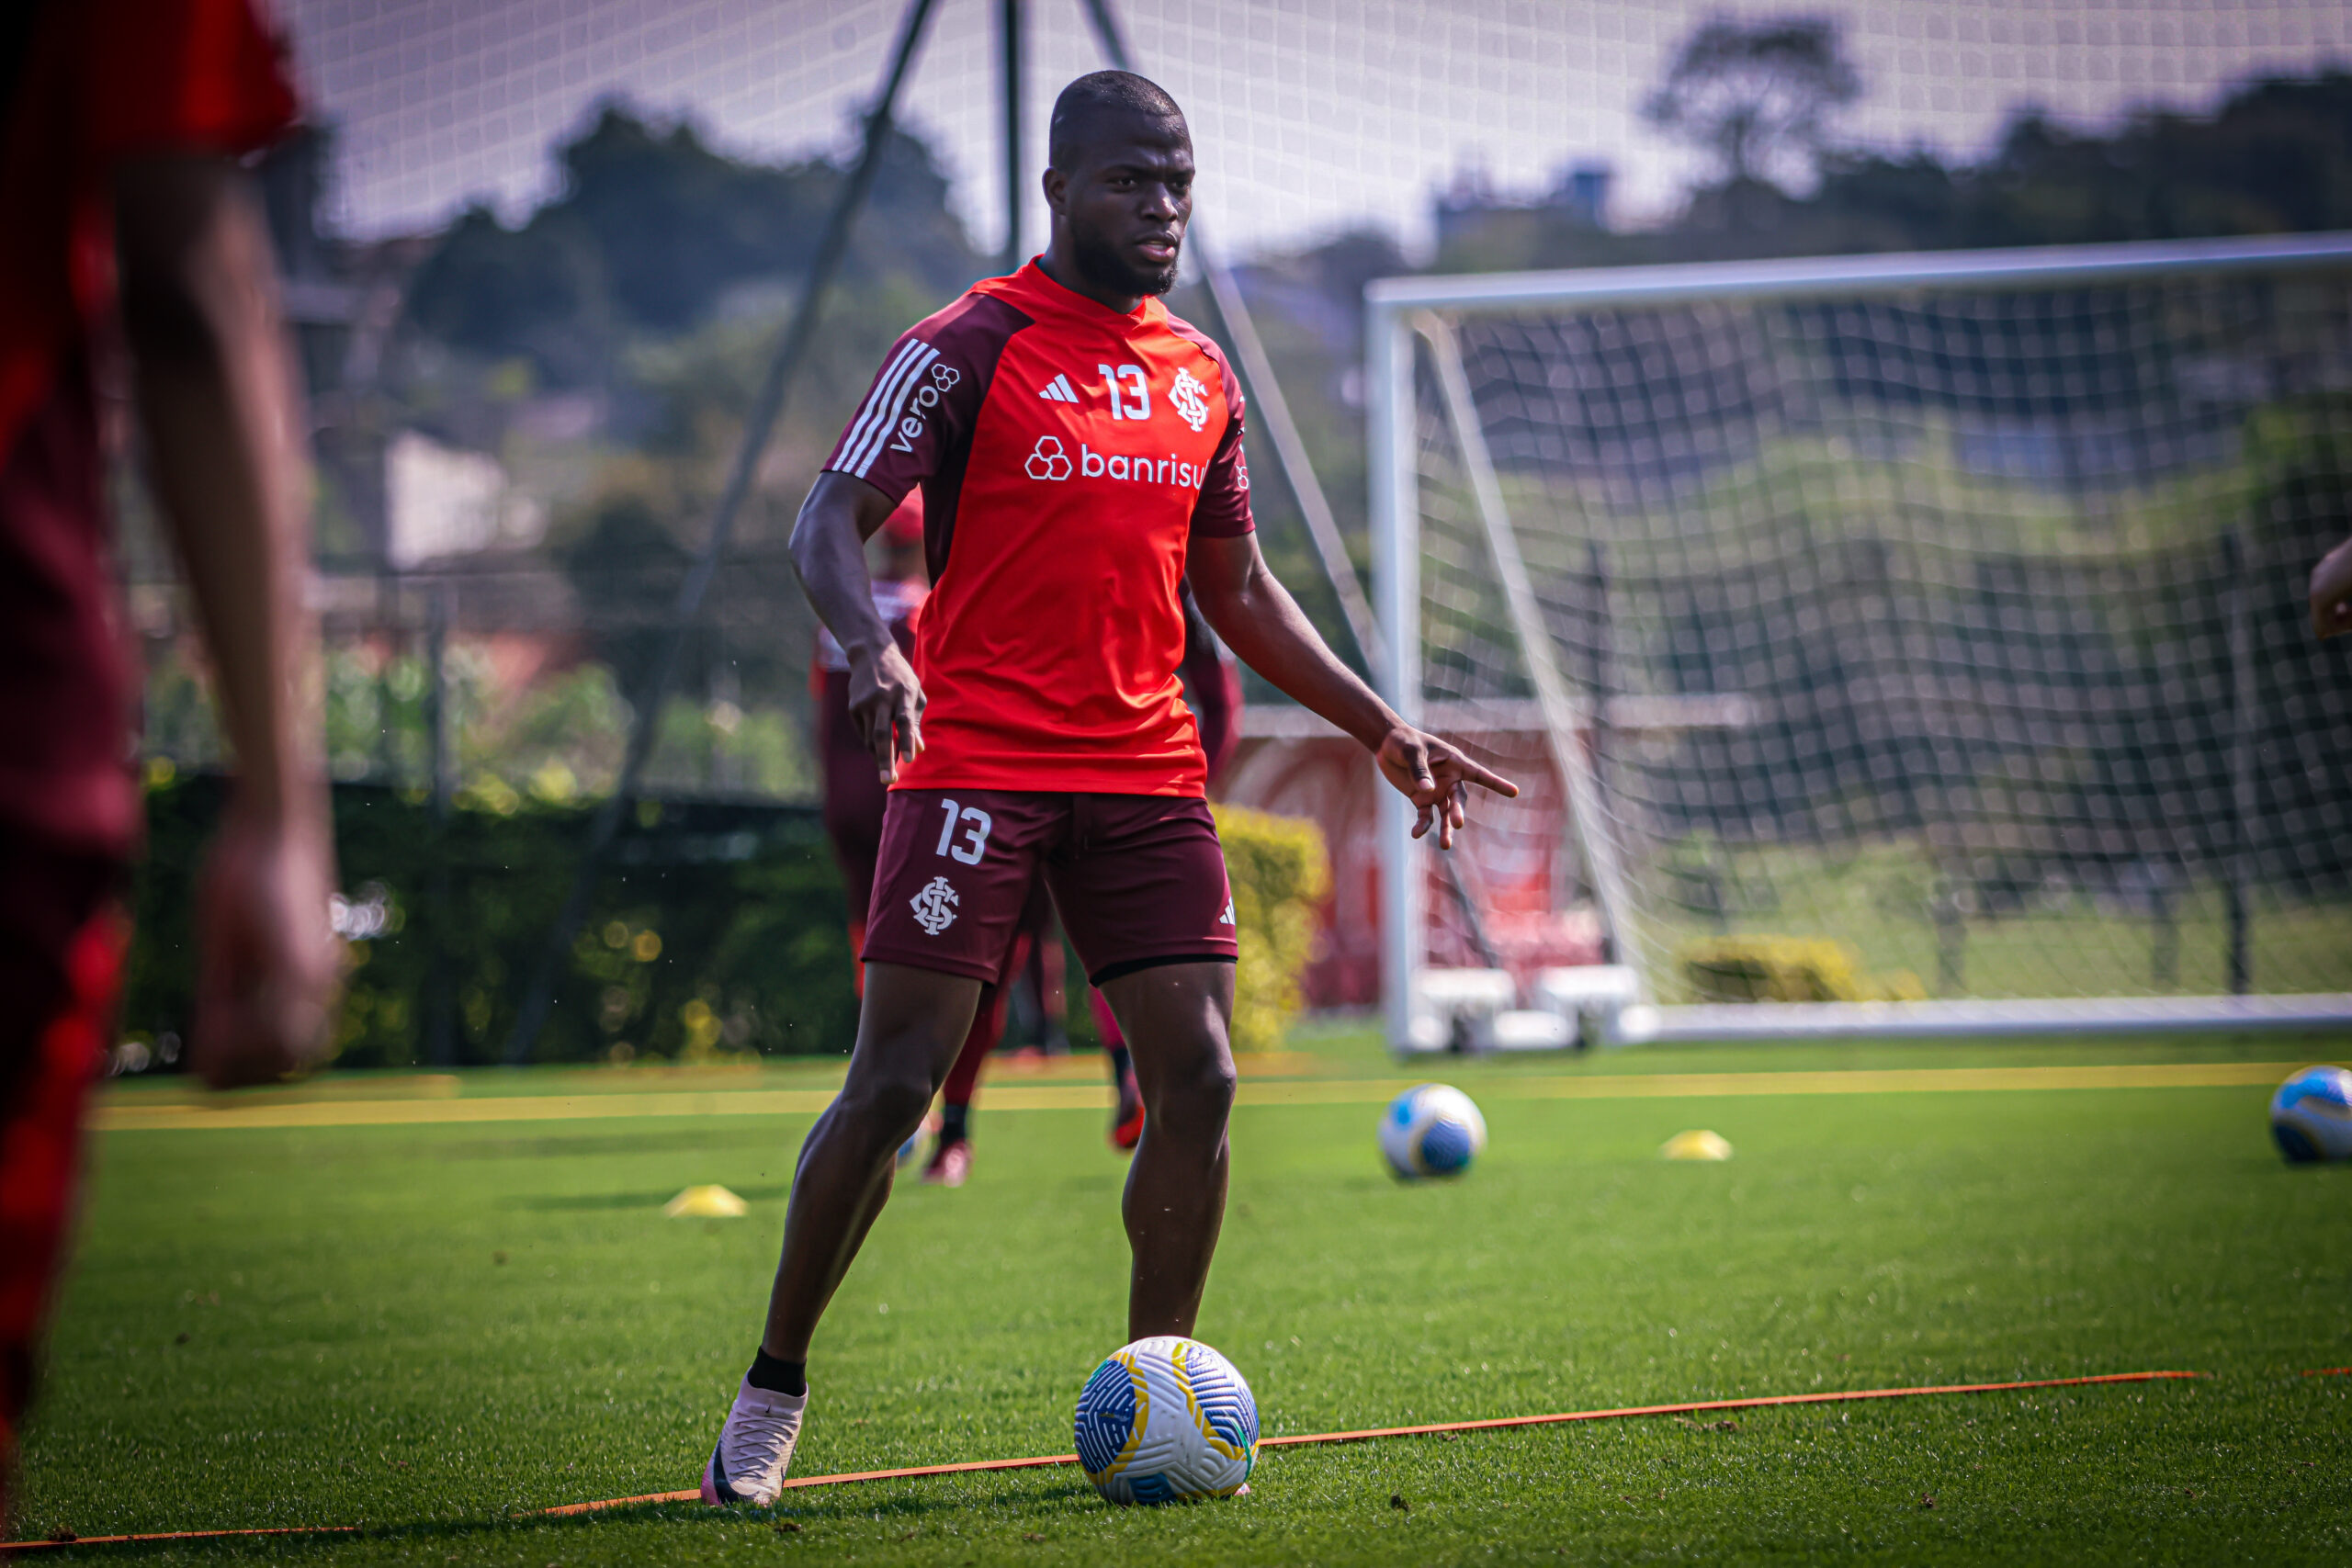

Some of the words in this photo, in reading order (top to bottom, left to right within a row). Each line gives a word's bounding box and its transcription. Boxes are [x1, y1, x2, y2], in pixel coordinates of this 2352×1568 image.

[889, 385, 939, 453] vero
[1098, 364, 1150, 420] 13
[935, 798, 991, 865] 13
